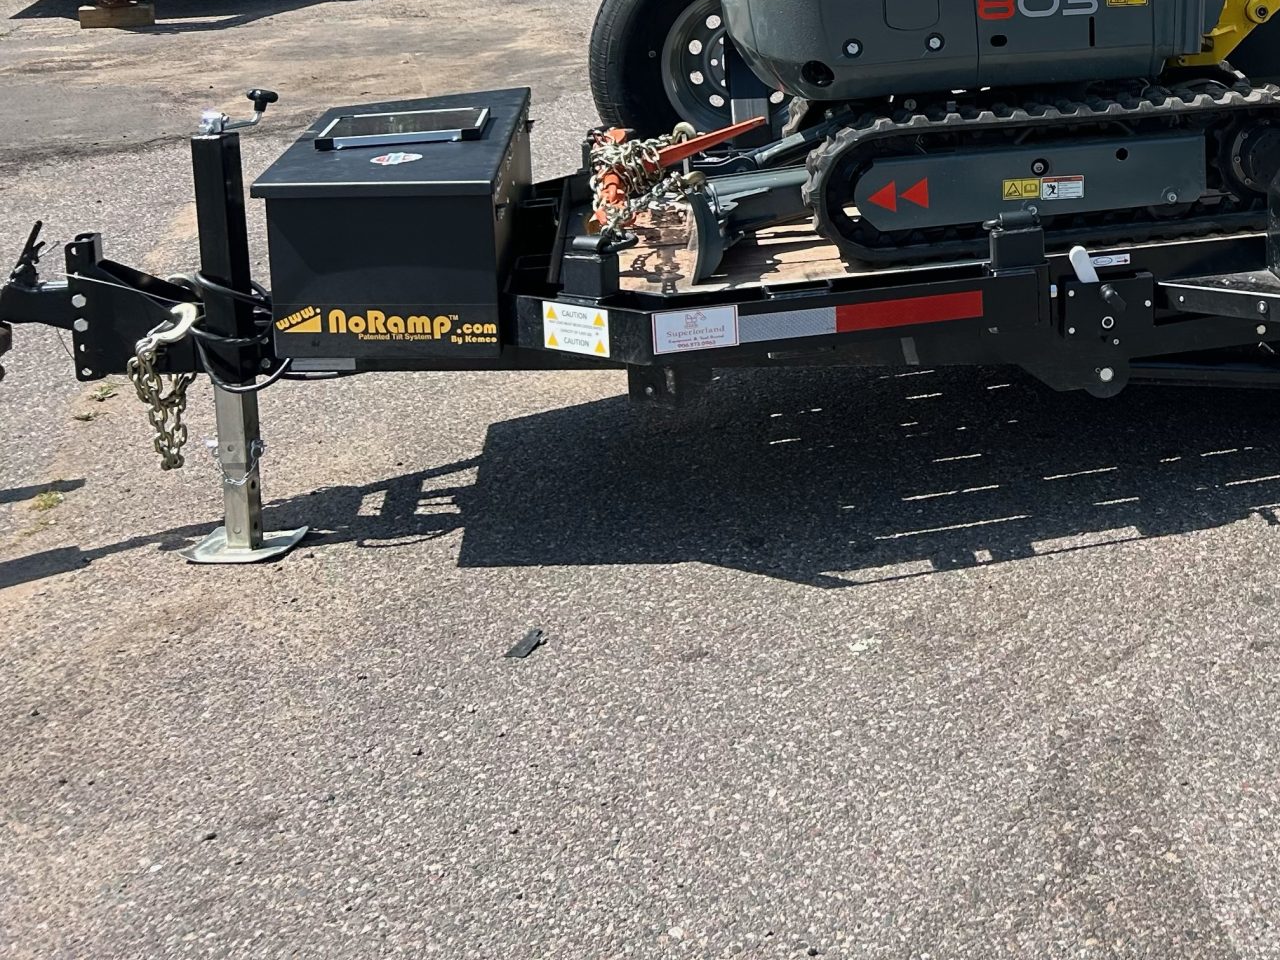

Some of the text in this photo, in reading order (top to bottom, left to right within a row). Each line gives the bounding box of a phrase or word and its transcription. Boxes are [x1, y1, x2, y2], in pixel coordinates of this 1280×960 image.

[561, 309, 588, 320] CAUTION
[275, 305, 321, 330] www.
[328, 309, 452, 339] NoRamp
[456, 323, 497, 334] .com
[666, 324, 725, 338] Superiorland
[404, 333, 432, 342] System
[451, 335, 498, 345] By Kemco
[563, 336, 590, 347] CAUTION
